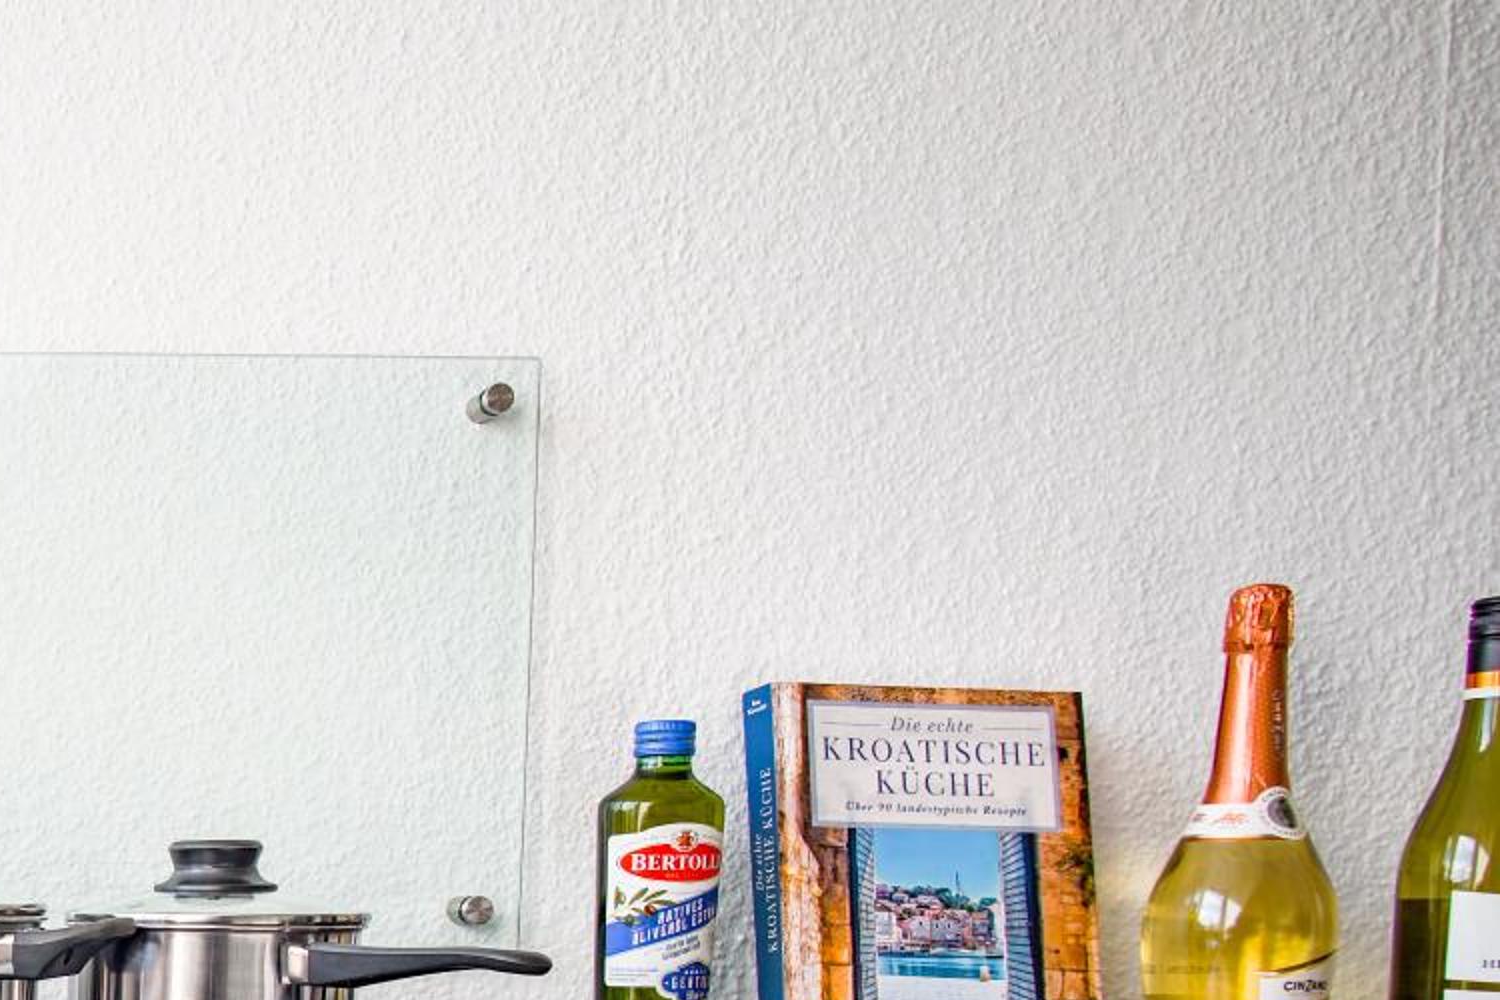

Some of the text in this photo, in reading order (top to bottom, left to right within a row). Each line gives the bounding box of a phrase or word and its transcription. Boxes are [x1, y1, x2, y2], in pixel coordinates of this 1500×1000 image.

[890, 716, 974, 734] Die echte
[823, 736, 1045, 767] KROATISCHE
[876, 766, 995, 797] KÜCHE
[845, 800, 1028, 818] Über 90 landestypische Rezepte
[631, 852, 720, 871] BERTOLL
[758, 768, 779, 953] KROATISCHE KÜCHE
